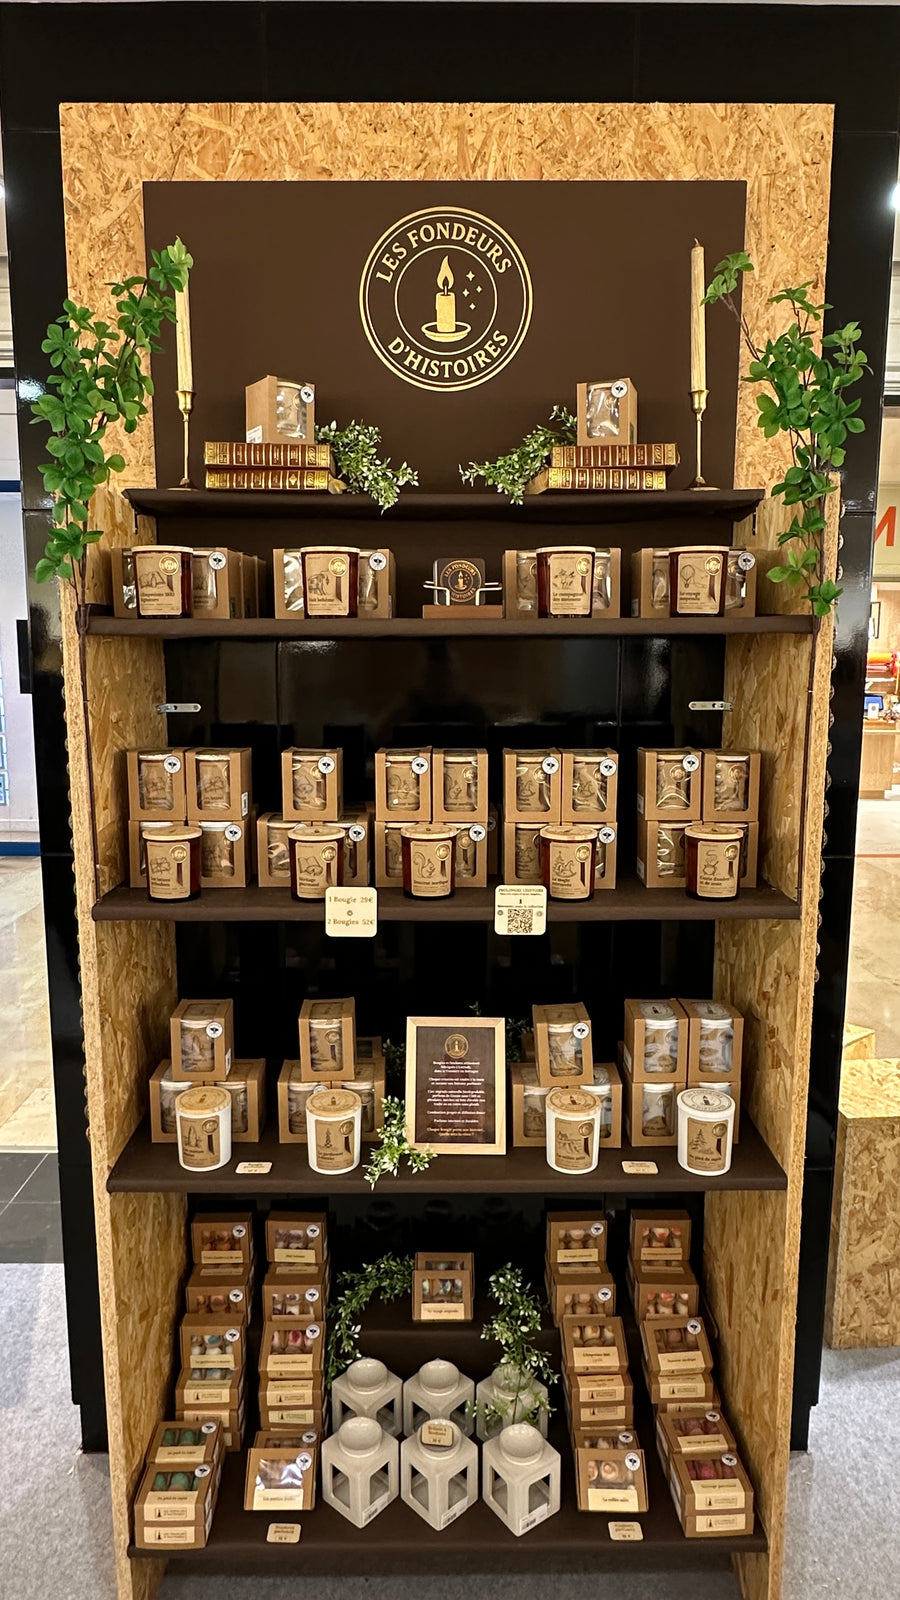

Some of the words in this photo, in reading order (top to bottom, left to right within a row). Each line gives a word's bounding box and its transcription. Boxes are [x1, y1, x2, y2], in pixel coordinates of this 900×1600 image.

[376, 242, 407, 284] LES
[406, 222, 512, 274] FONDEURS
[388, 330, 508, 378] D'HISTOIRES
[334, 896, 357, 904] Bougie
[333, 918, 359, 926] Bougies
